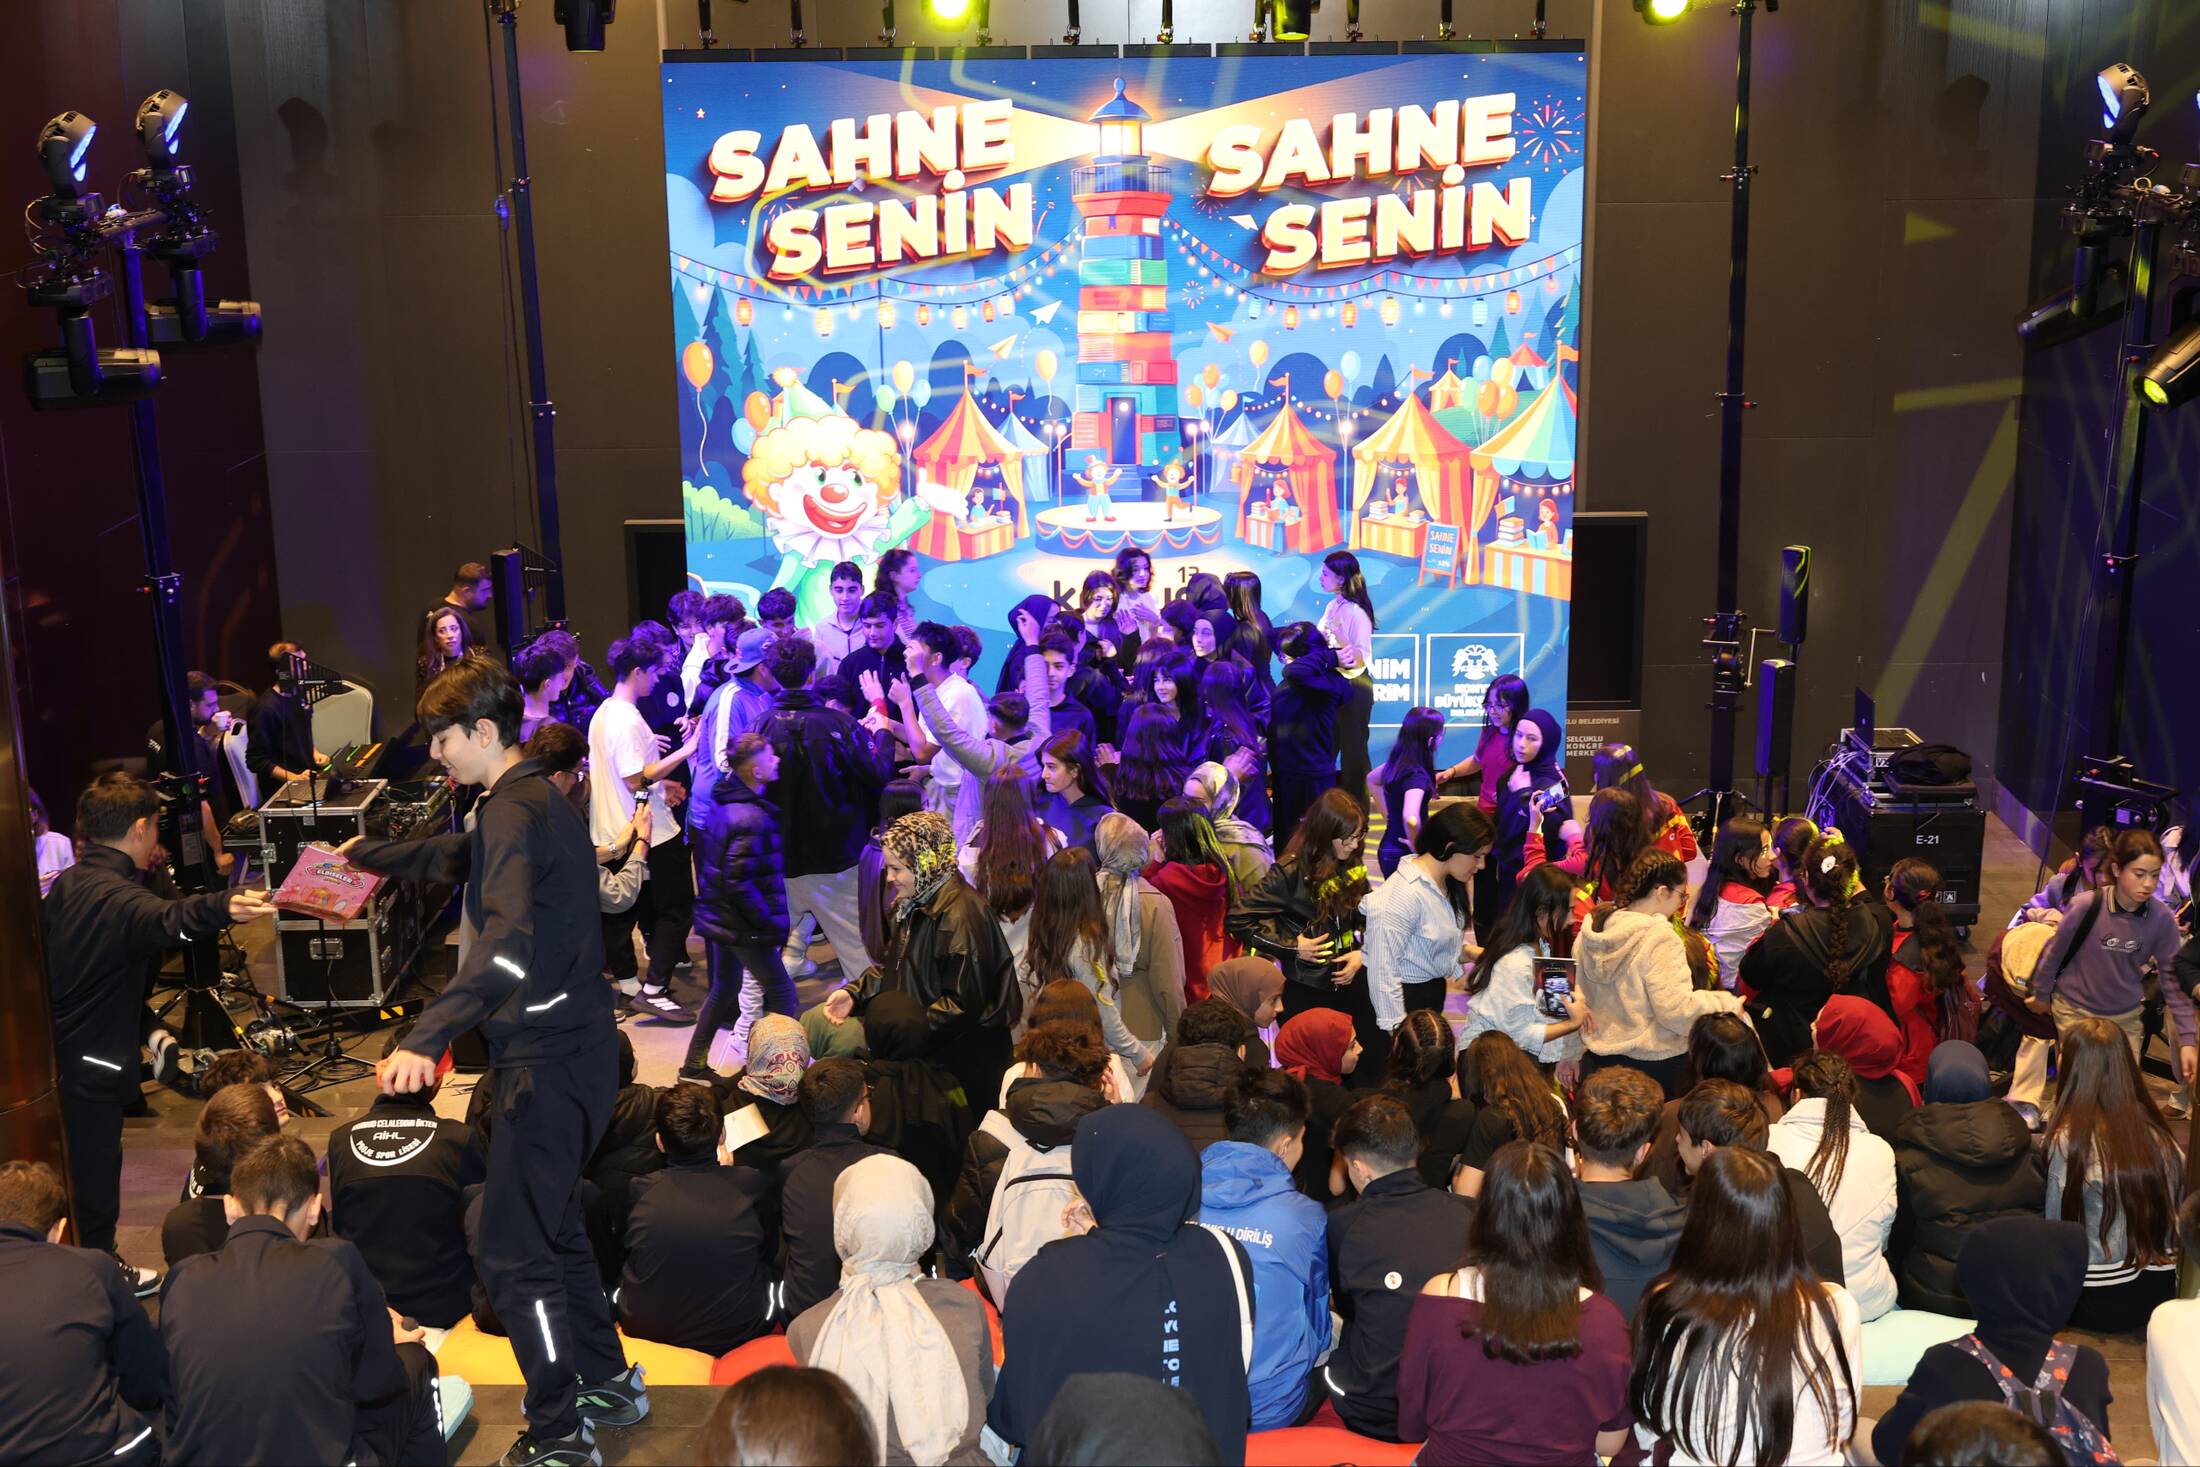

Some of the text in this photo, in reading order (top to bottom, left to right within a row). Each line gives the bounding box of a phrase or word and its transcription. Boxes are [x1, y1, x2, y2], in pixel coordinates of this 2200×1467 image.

[708, 99, 1016, 203] SAHNE
[1206, 92, 1517, 198] SAHNE
[766, 169, 1034, 281] SENİN
[1261, 163, 1533, 276] SENİN
[1369, 658, 1410, 679] NİM
[1373, 683, 1410, 701] RİM
[1916, 835, 1939, 844] E-21
[373, 1131, 406, 1140] AİHL
[356, 1140, 375, 1157] PROJE
[375, 1150, 396, 1159] SPOR
[1235, 1226, 1273, 1249] DİRİLİŞ
